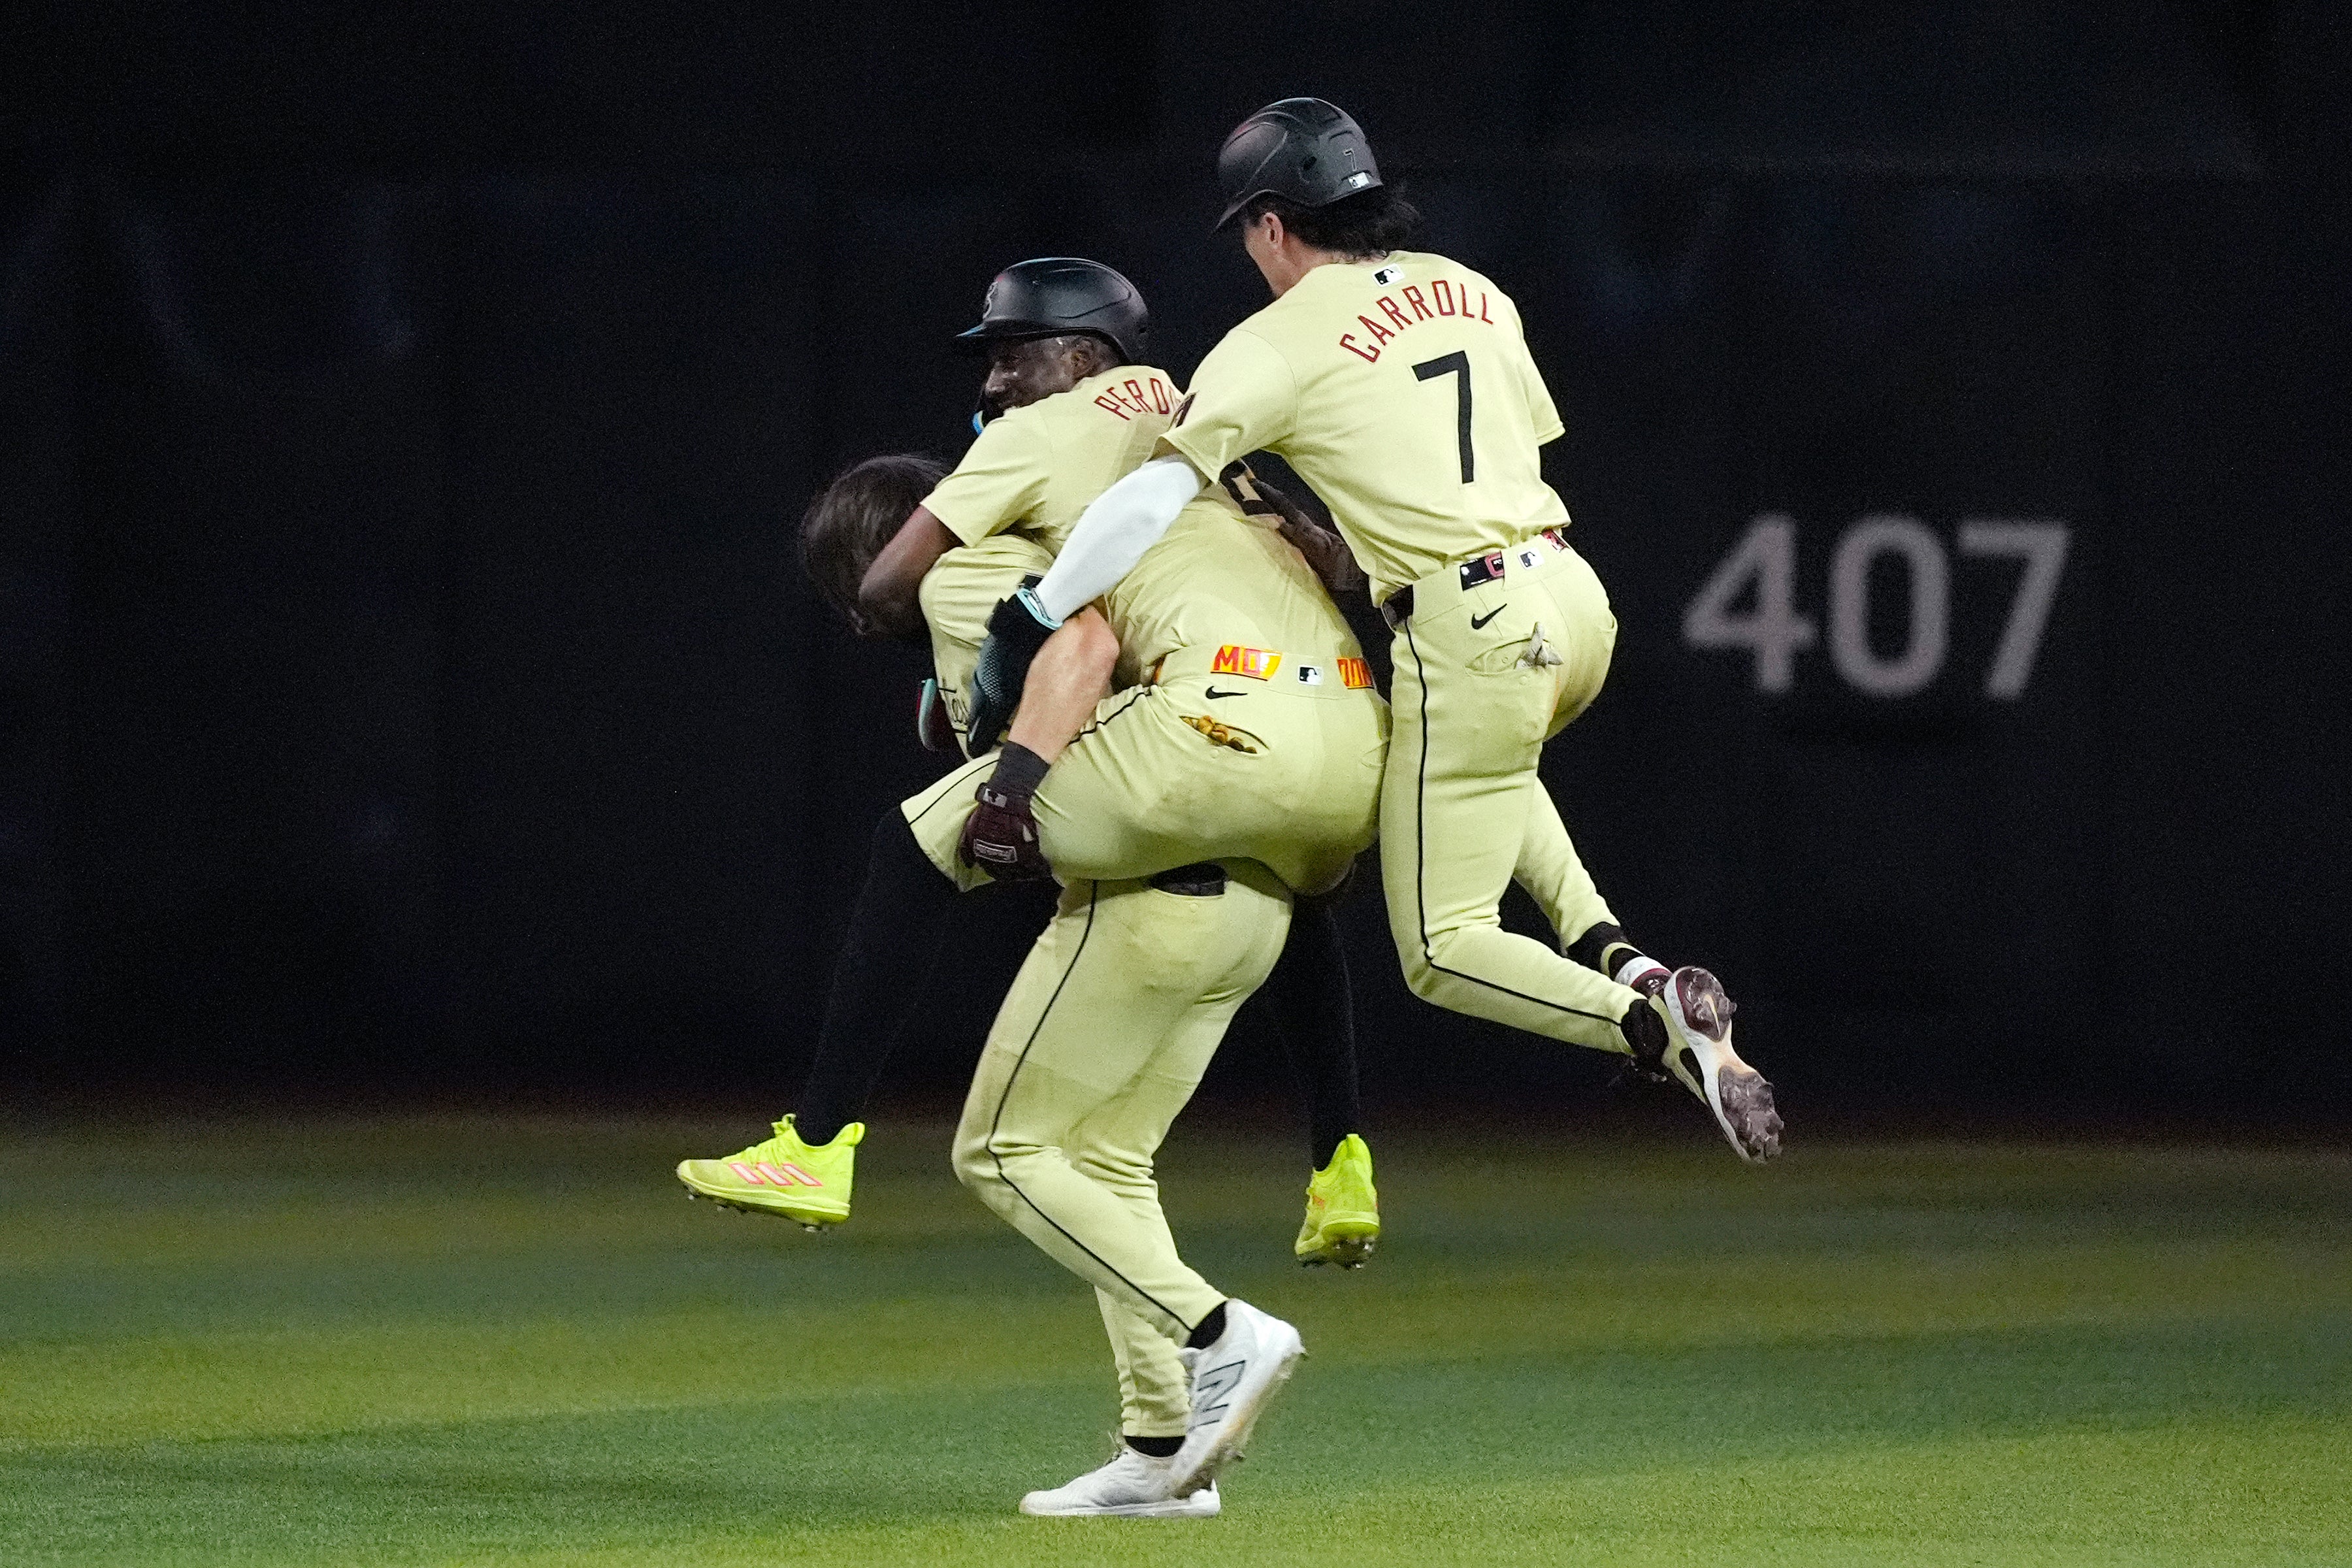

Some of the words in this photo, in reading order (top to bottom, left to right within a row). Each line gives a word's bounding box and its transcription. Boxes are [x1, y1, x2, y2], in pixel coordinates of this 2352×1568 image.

[1343, 148, 1357, 171] 7
[1339, 280, 1494, 363] CARROLL
[1410, 350, 1475, 485] 7
[1684, 514, 2071, 701] 407
